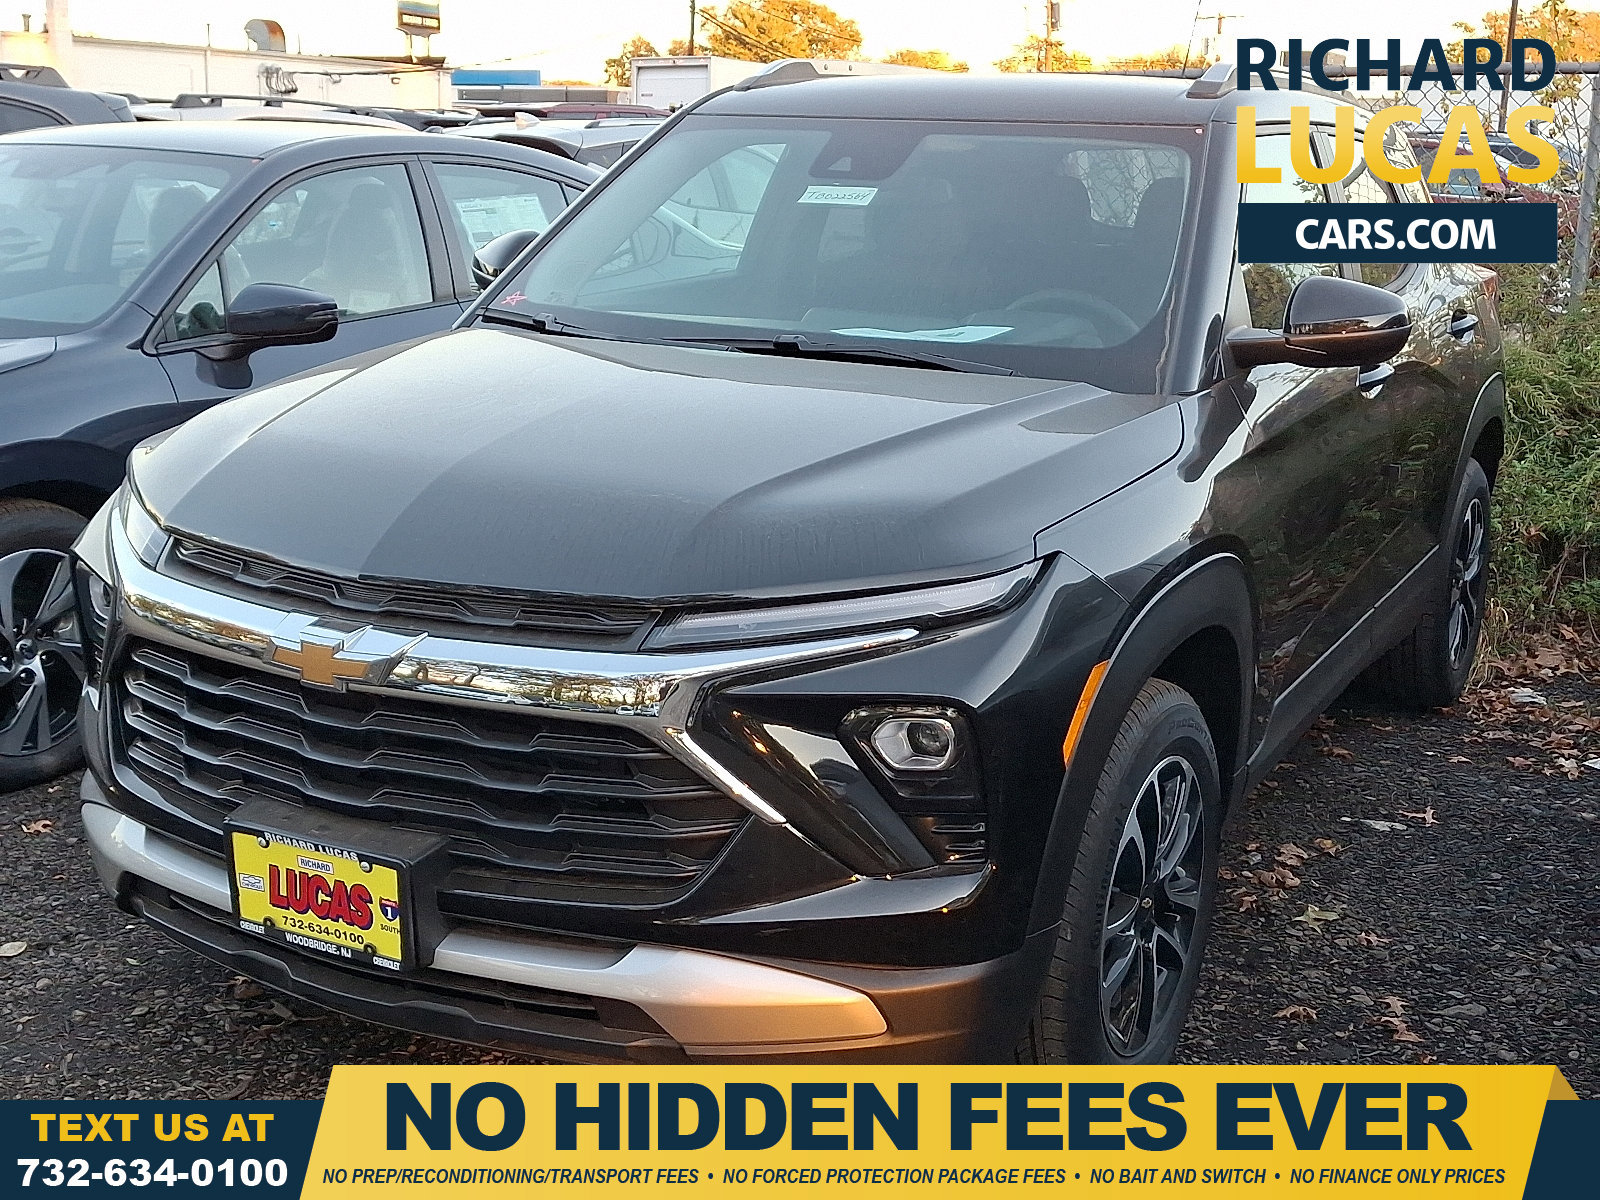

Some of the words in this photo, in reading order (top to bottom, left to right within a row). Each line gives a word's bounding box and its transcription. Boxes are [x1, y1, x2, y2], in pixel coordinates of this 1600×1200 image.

[264, 832, 316, 852] RICHARD
[318, 845, 359, 862] LUCAS
[300, 858, 331, 873] RICHARD
[268, 863, 374, 931] LUCAS
[384, 906, 394, 920] 1
[281, 915, 365, 945] 732-634-0100
[380, 923, 401, 935] SOUTH
[284, 931, 340, 956] WOODBRIDGE,
[340, 946, 352, 959] NJ
